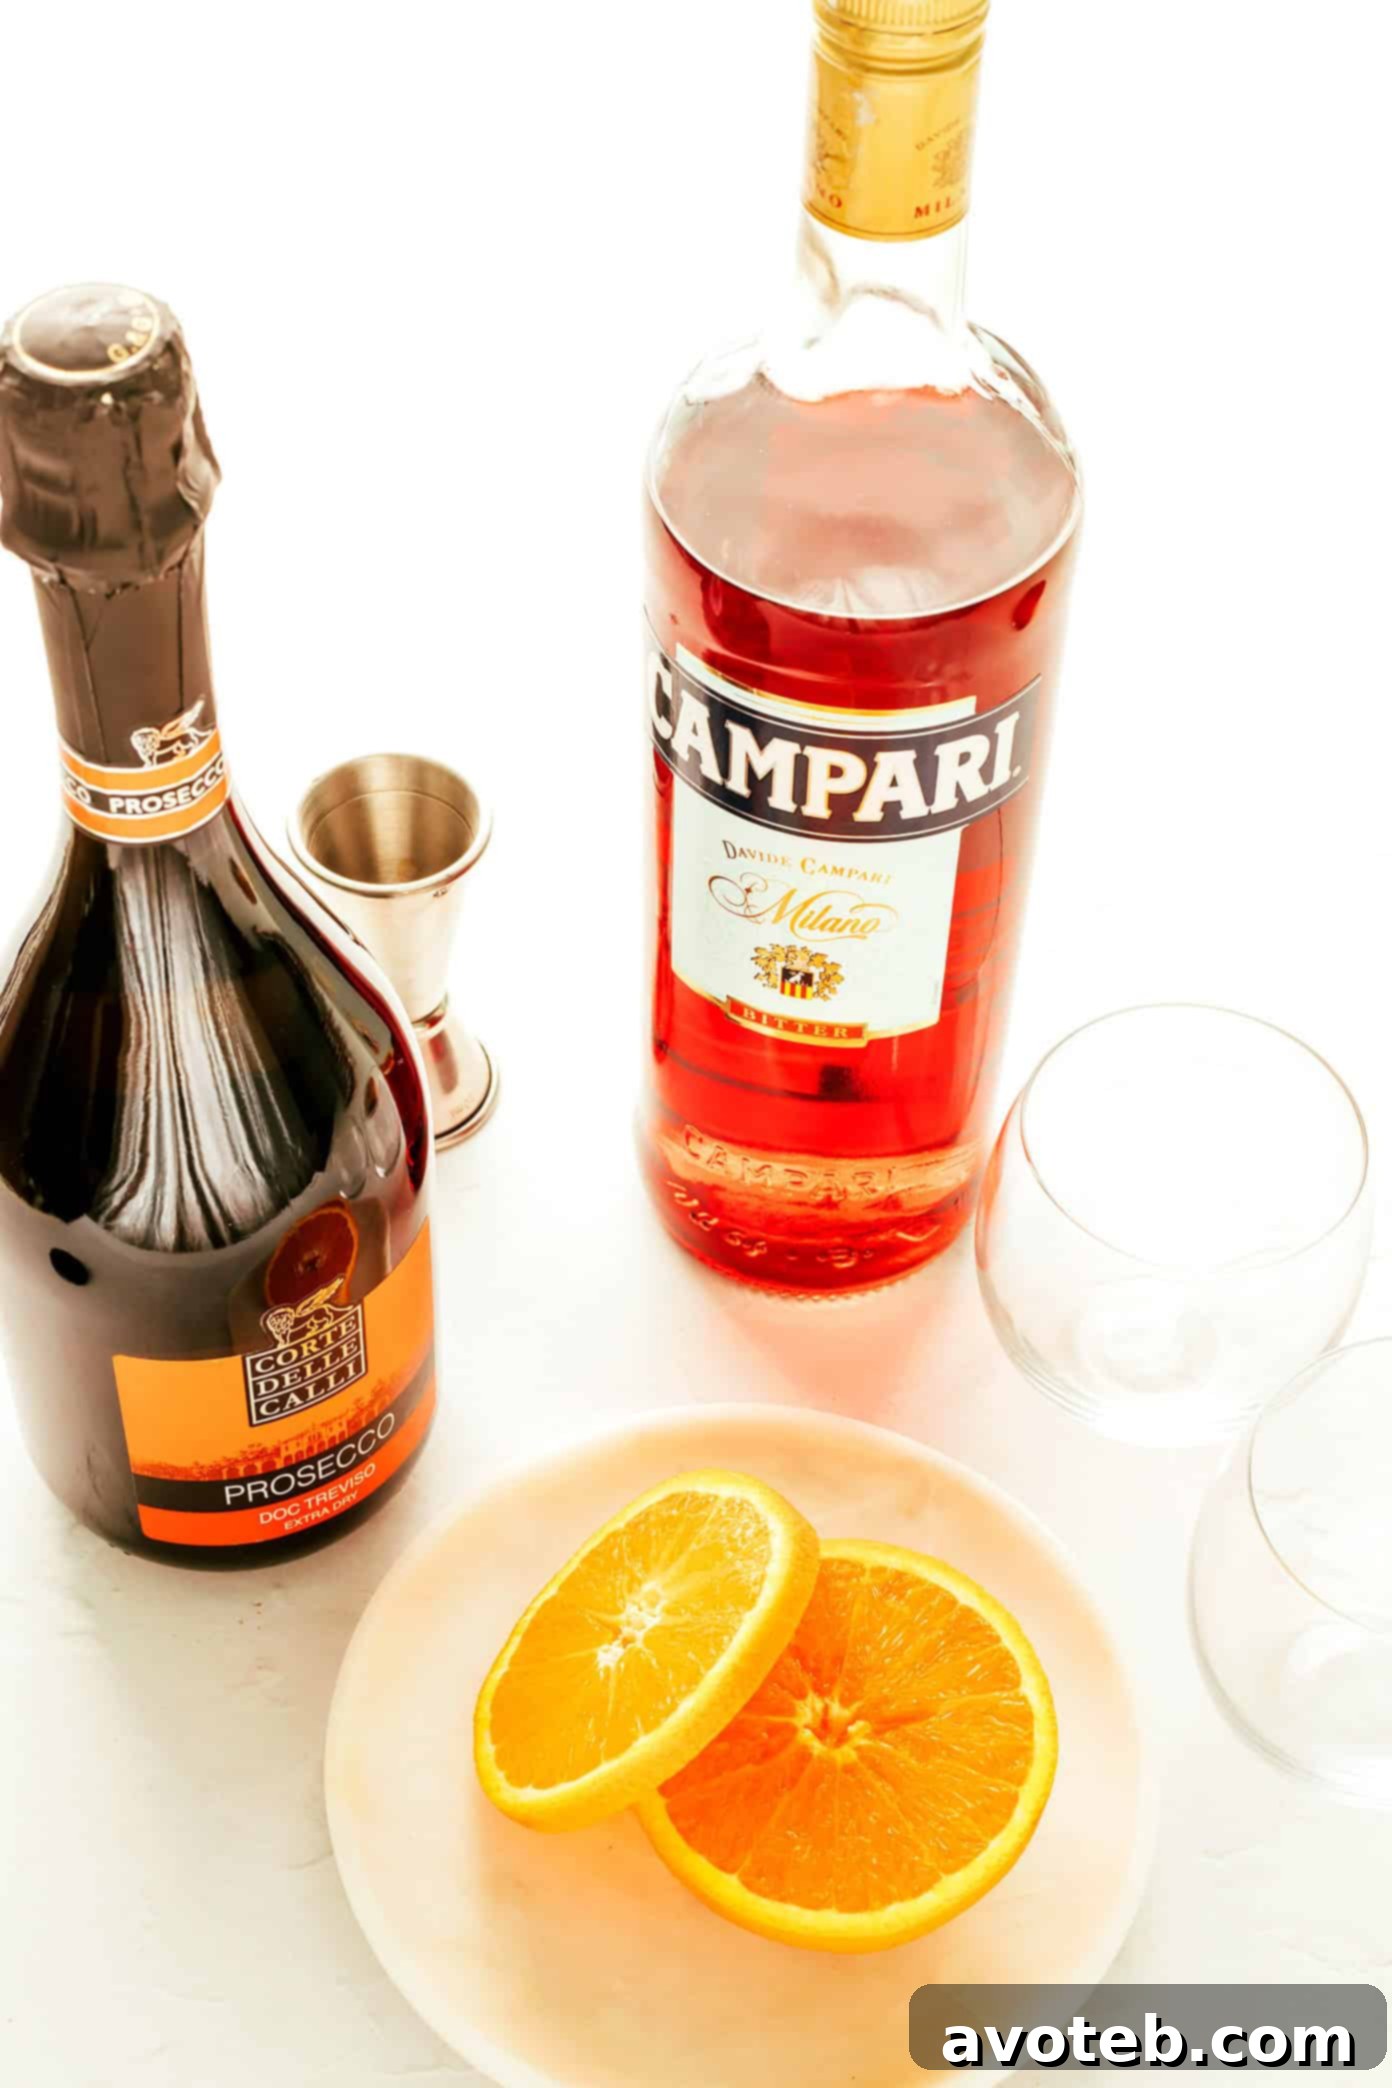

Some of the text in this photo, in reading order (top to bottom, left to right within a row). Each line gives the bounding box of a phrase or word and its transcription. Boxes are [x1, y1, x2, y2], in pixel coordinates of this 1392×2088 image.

[720, 876, 898, 942] Milano
[743, 1007, 848, 1038] BITTER
[255, 1315, 355, 1374] CORTE
[256, 1337, 358, 1396] DELLE
[259, 1360, 356, 1416] CALLI
[224, 1412, 395, 1506] PROSECCO
[259, 1462, 377, 1525] DOC TREVISO
[284, 1490, 359, 1531] EXTRA DRY
